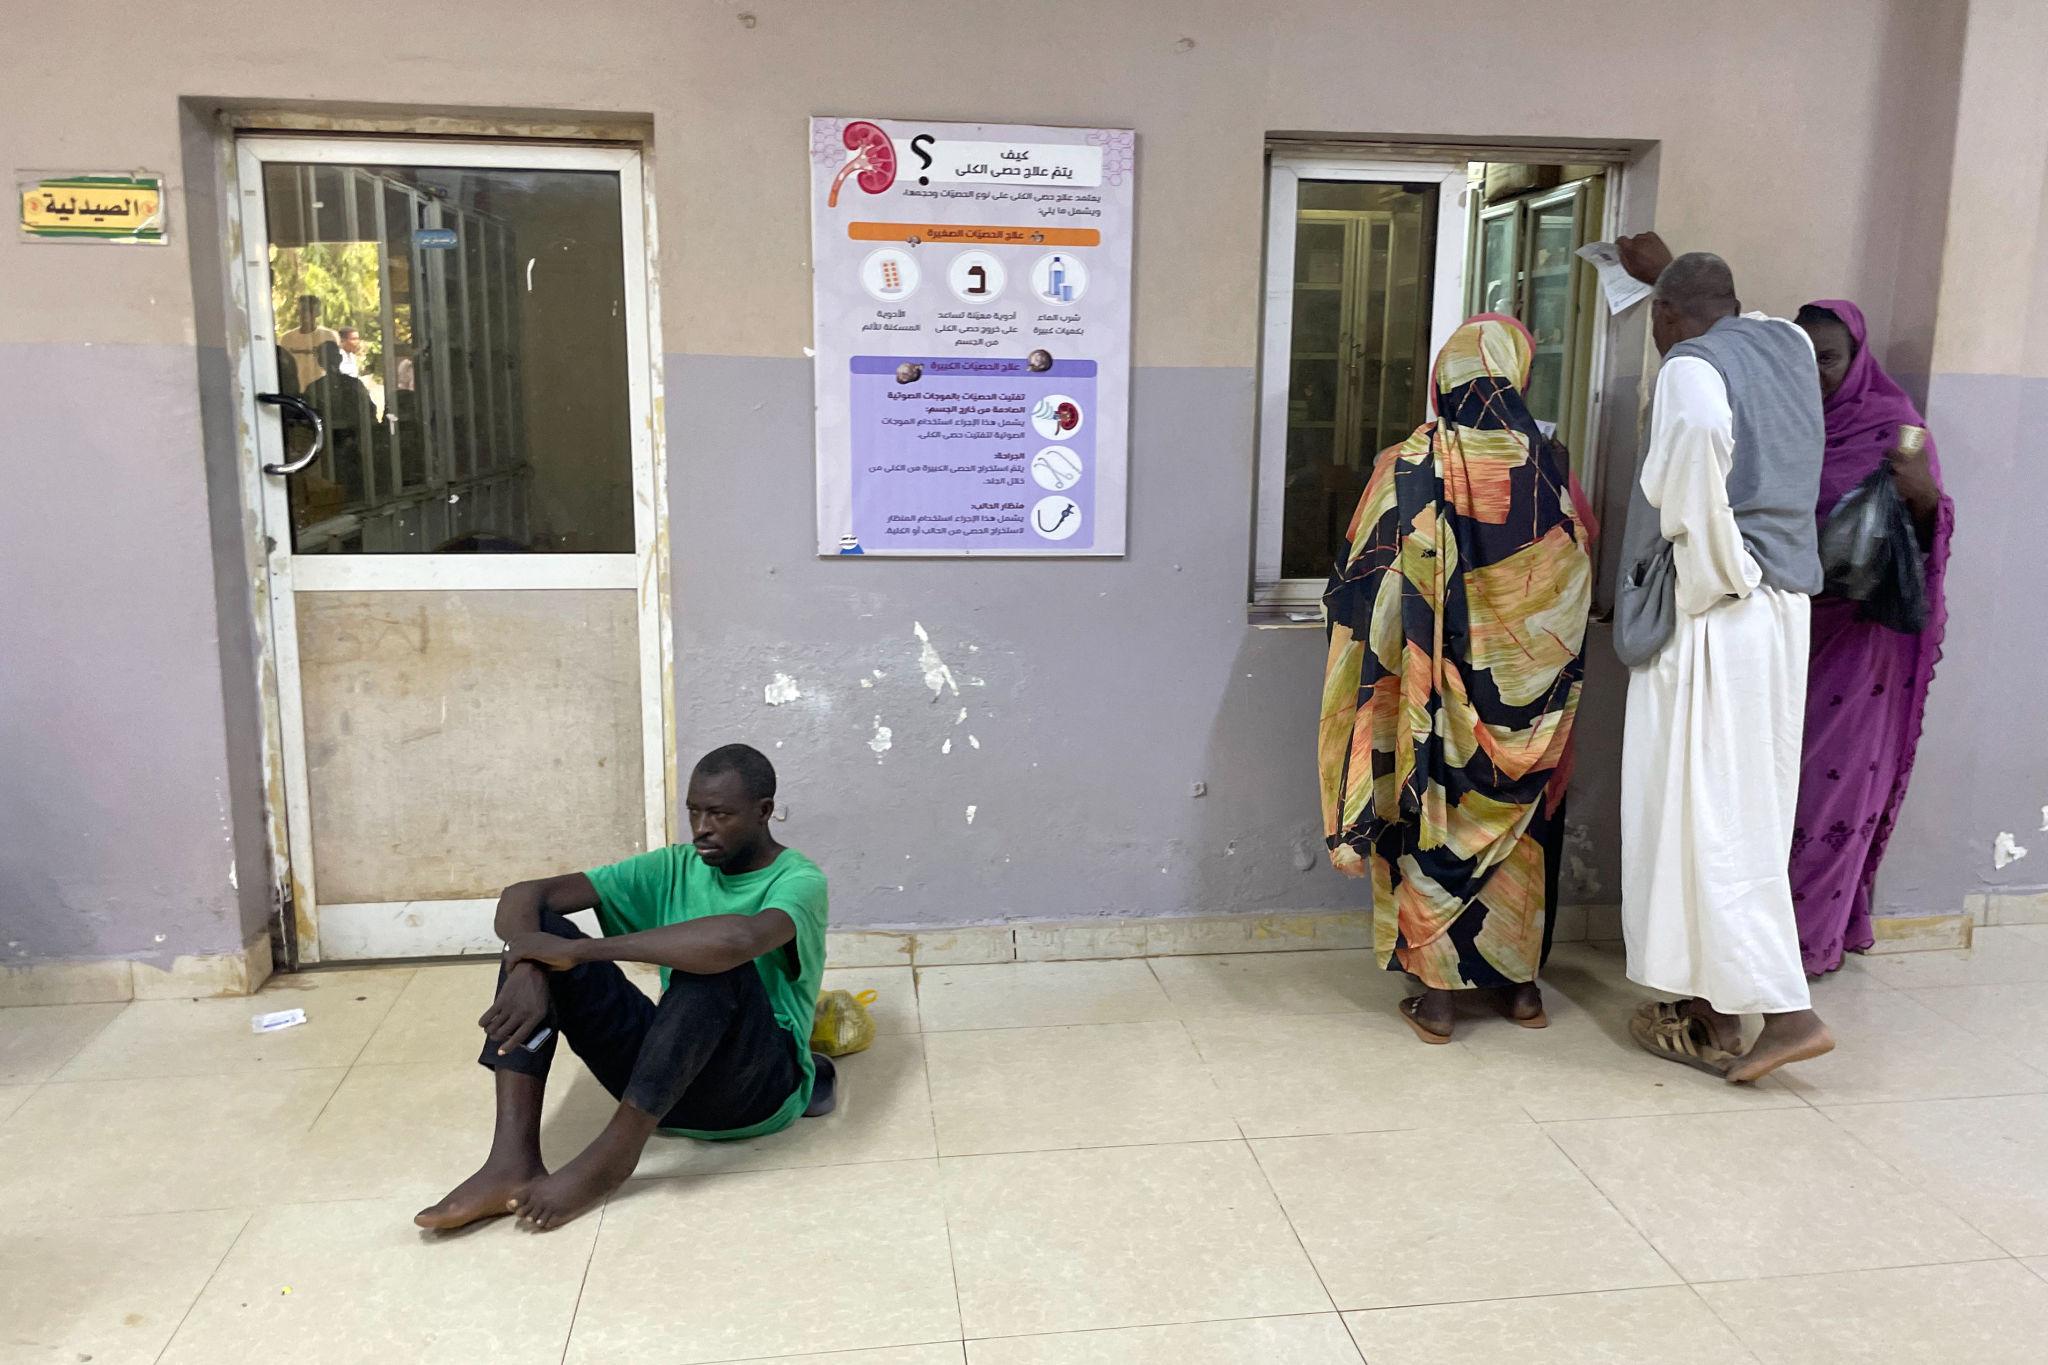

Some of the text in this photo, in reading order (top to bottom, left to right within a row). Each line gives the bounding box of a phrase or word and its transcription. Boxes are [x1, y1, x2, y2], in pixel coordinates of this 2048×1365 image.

[910, 133, 1029, 186] كيف ؟
[955, 164, 988, 176] الكلى
[990, 166, 1021, 178] حصى
[1023, 165, 1049, 179] علاج
[975, 190, 991, 200] نوع
[991, 191, 1009, 201] على
[1010, 191, 1033, 201] الكلى
[1033, 192, 1054, 202] حصى
[1056, 193, 1073, 203] علاج
[1075, 194, 1101, 203] يعتمد
[43, 193, 139, 221] الصيدلية
[1057, 206, 1066, 215] ما
[1068, 207, 1101, 217] ويشمل
[927, 229, 964, 239] الصغيرة
[1005, 231, 1024, 241] علاج
[938, 311, 965, 319] تساعد
[1037, 313, 1081, 324] شرب الماء
[935, 324, 1019, 335] على خروج حصى الكلى
[1033, 326, 1054, 336] كبيرة
[954, 338, 999, 348] من الجسم
[930, 360, 961, 371] الكبيرة
[1001, 362, 1021, 372] علاج
[887, 391, 922, 400] الصوتية
[922, 391, 960, 401] بالموجات
[999, 392, 1026, 402] تفتيت
[958, 405, 976, 415] خارج
[977, 407, 991, 415] من
[992, 405, 1026, 414] الصادمة
[881, 416, 915, 427] الموجات
[916, 418, 954, 427] استخدام
[981, 418, 996, 426] هذا
[997, 418, 1025, 428] يشمل
[943, 431, 963, 440] حصى
[993, 431, 1025, 441] الصوتية
[868, 464, 883, 473] من
[884, 464, 906, 473] الكلى
[907, 465, 921, 473] من
[922, 464, 949, 473] الكبيرة
[950, 464, 976, 474] الحصى
[977, 464, 1009, 474] استخراج
[1006, 477, 1025, 486] خلال
[1000, 502, 1025, 511] منظار
[886, 514, 916, 524] المنظار
[917, 514, 953, 523] استخدام
[997, 514, 1025, 524] يشمل
[922, 527, 946, 535] الحالب
[948, 528, 961, 537] من
[962, 527, 989, 536] الحصى
